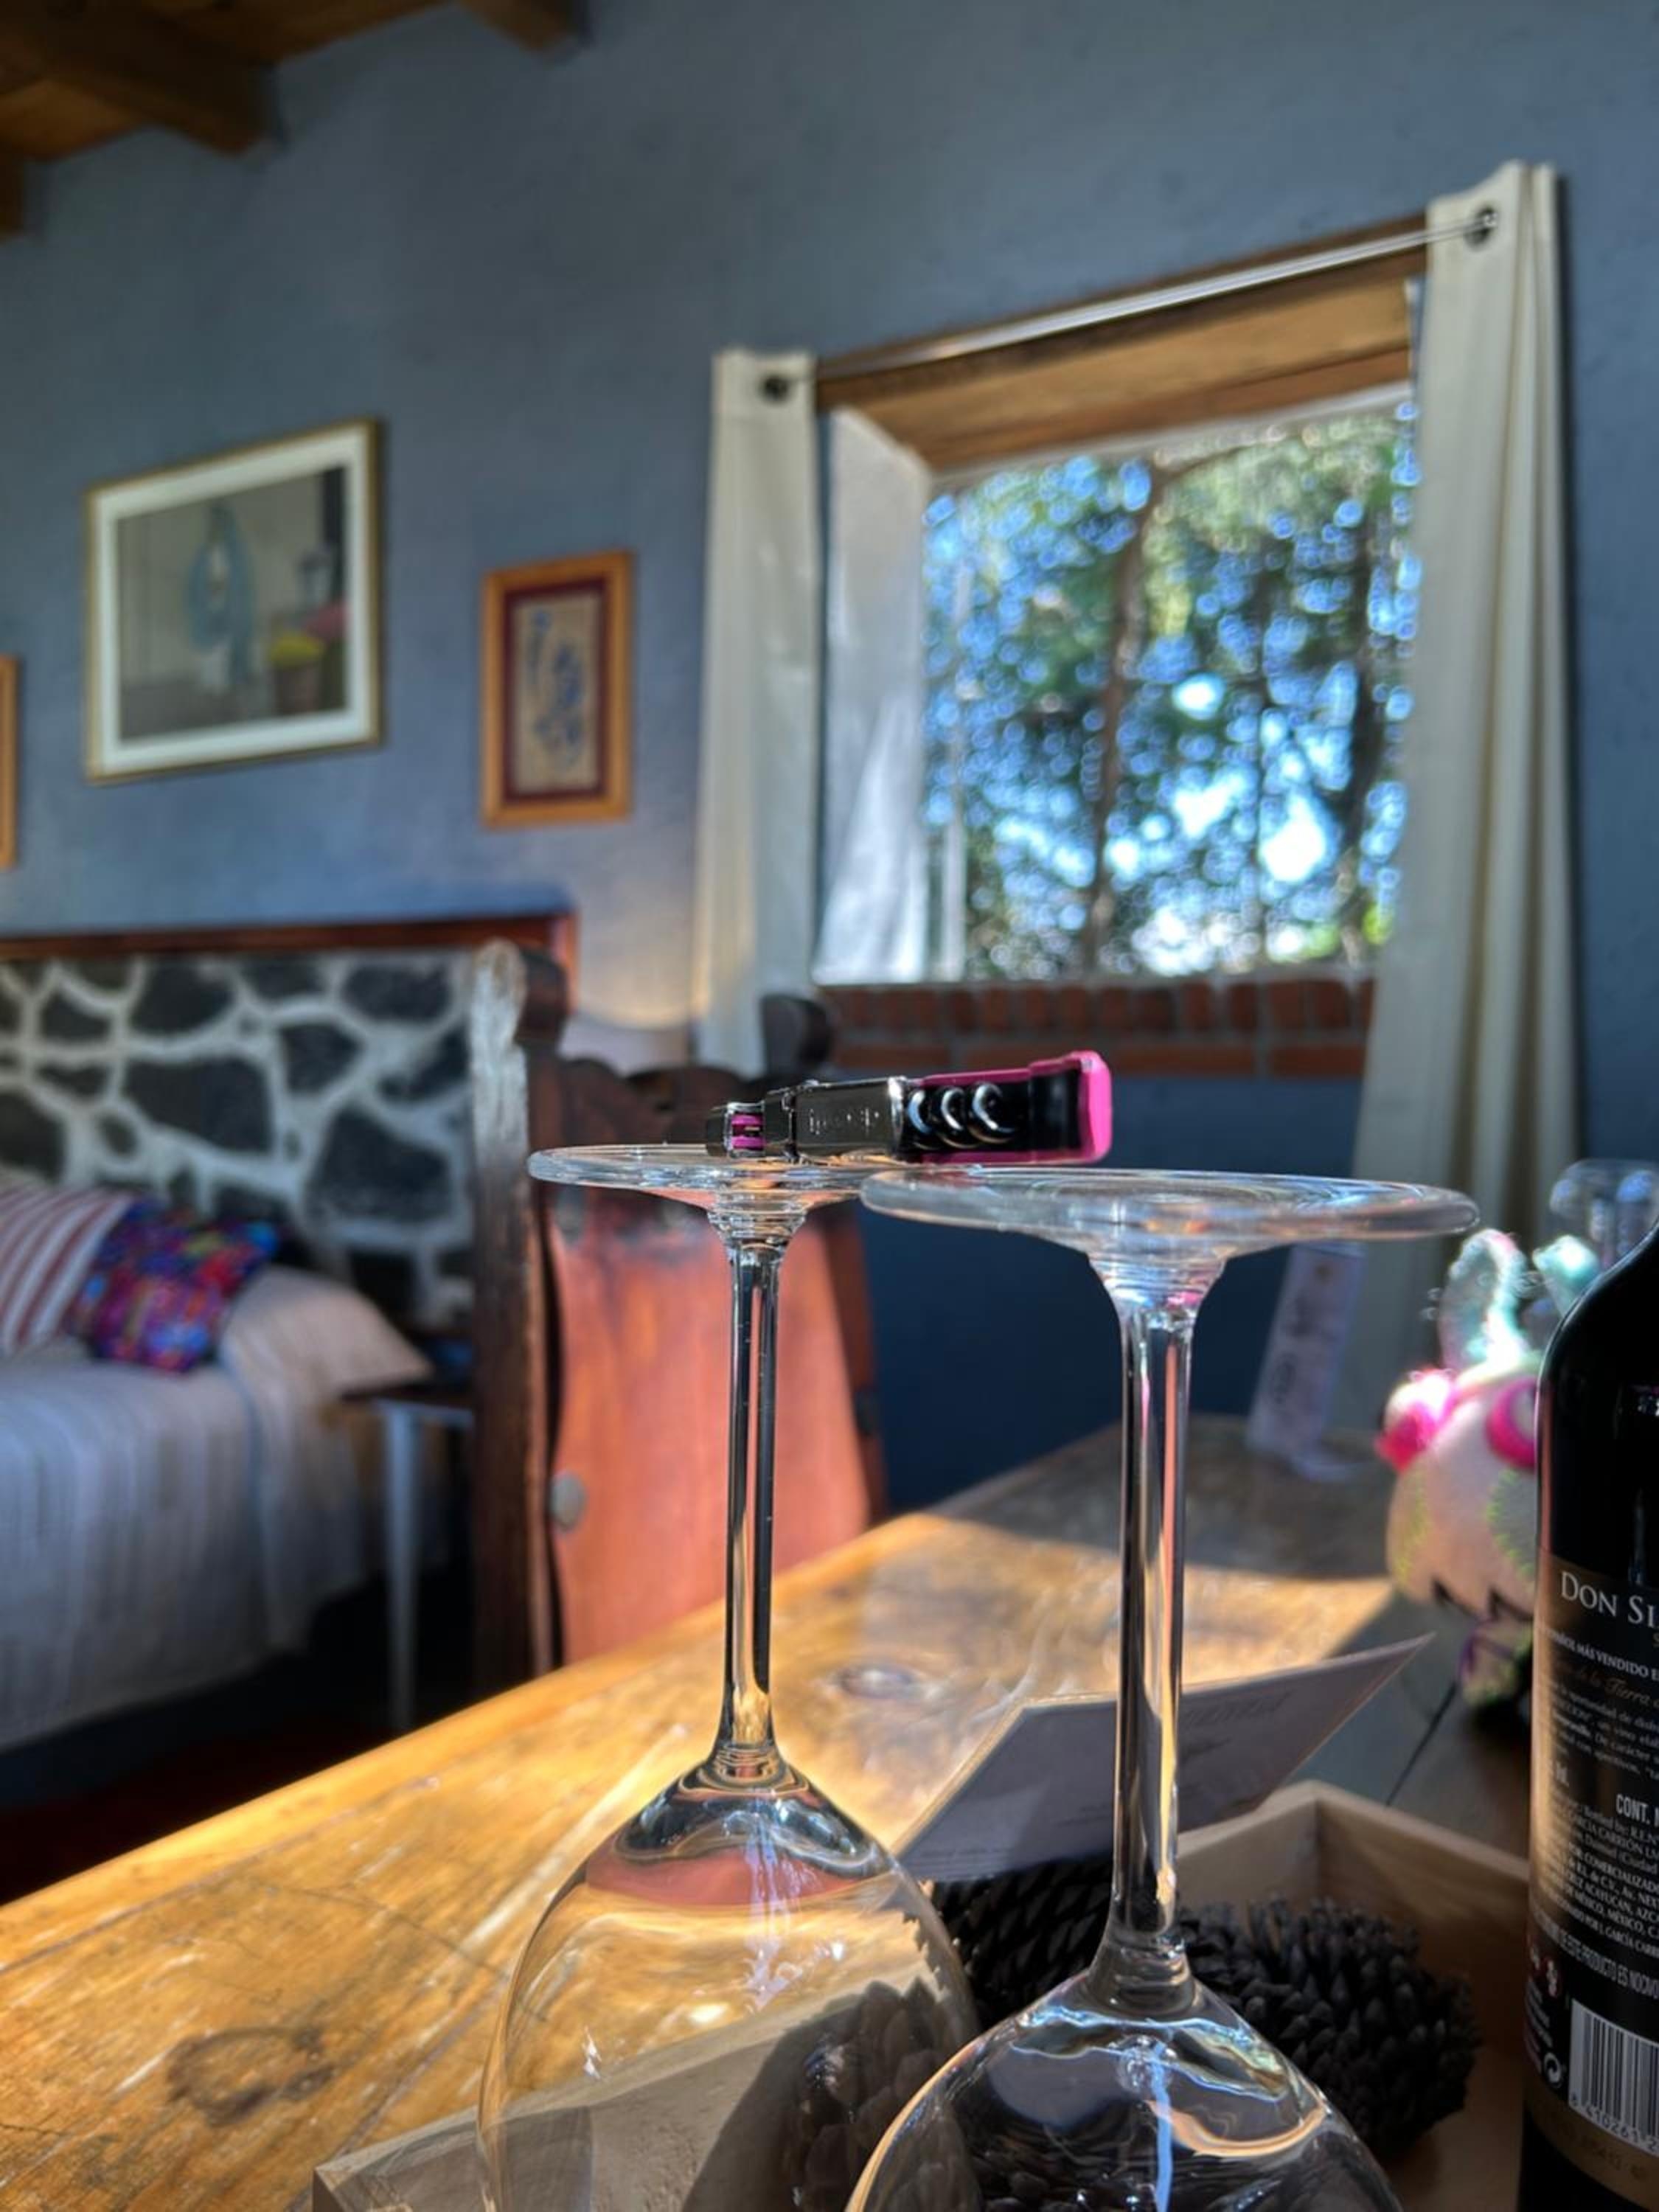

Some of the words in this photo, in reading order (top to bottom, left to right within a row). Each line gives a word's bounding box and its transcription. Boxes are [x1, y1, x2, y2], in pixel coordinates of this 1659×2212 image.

[1561, 1571, 1618, 1618] DON
[1627, 1595, 1659, 1629] SI
[1596, 1651, 1649, 1678] VENDIDO
[1616, 1793, 1650, 1826] CONT.
